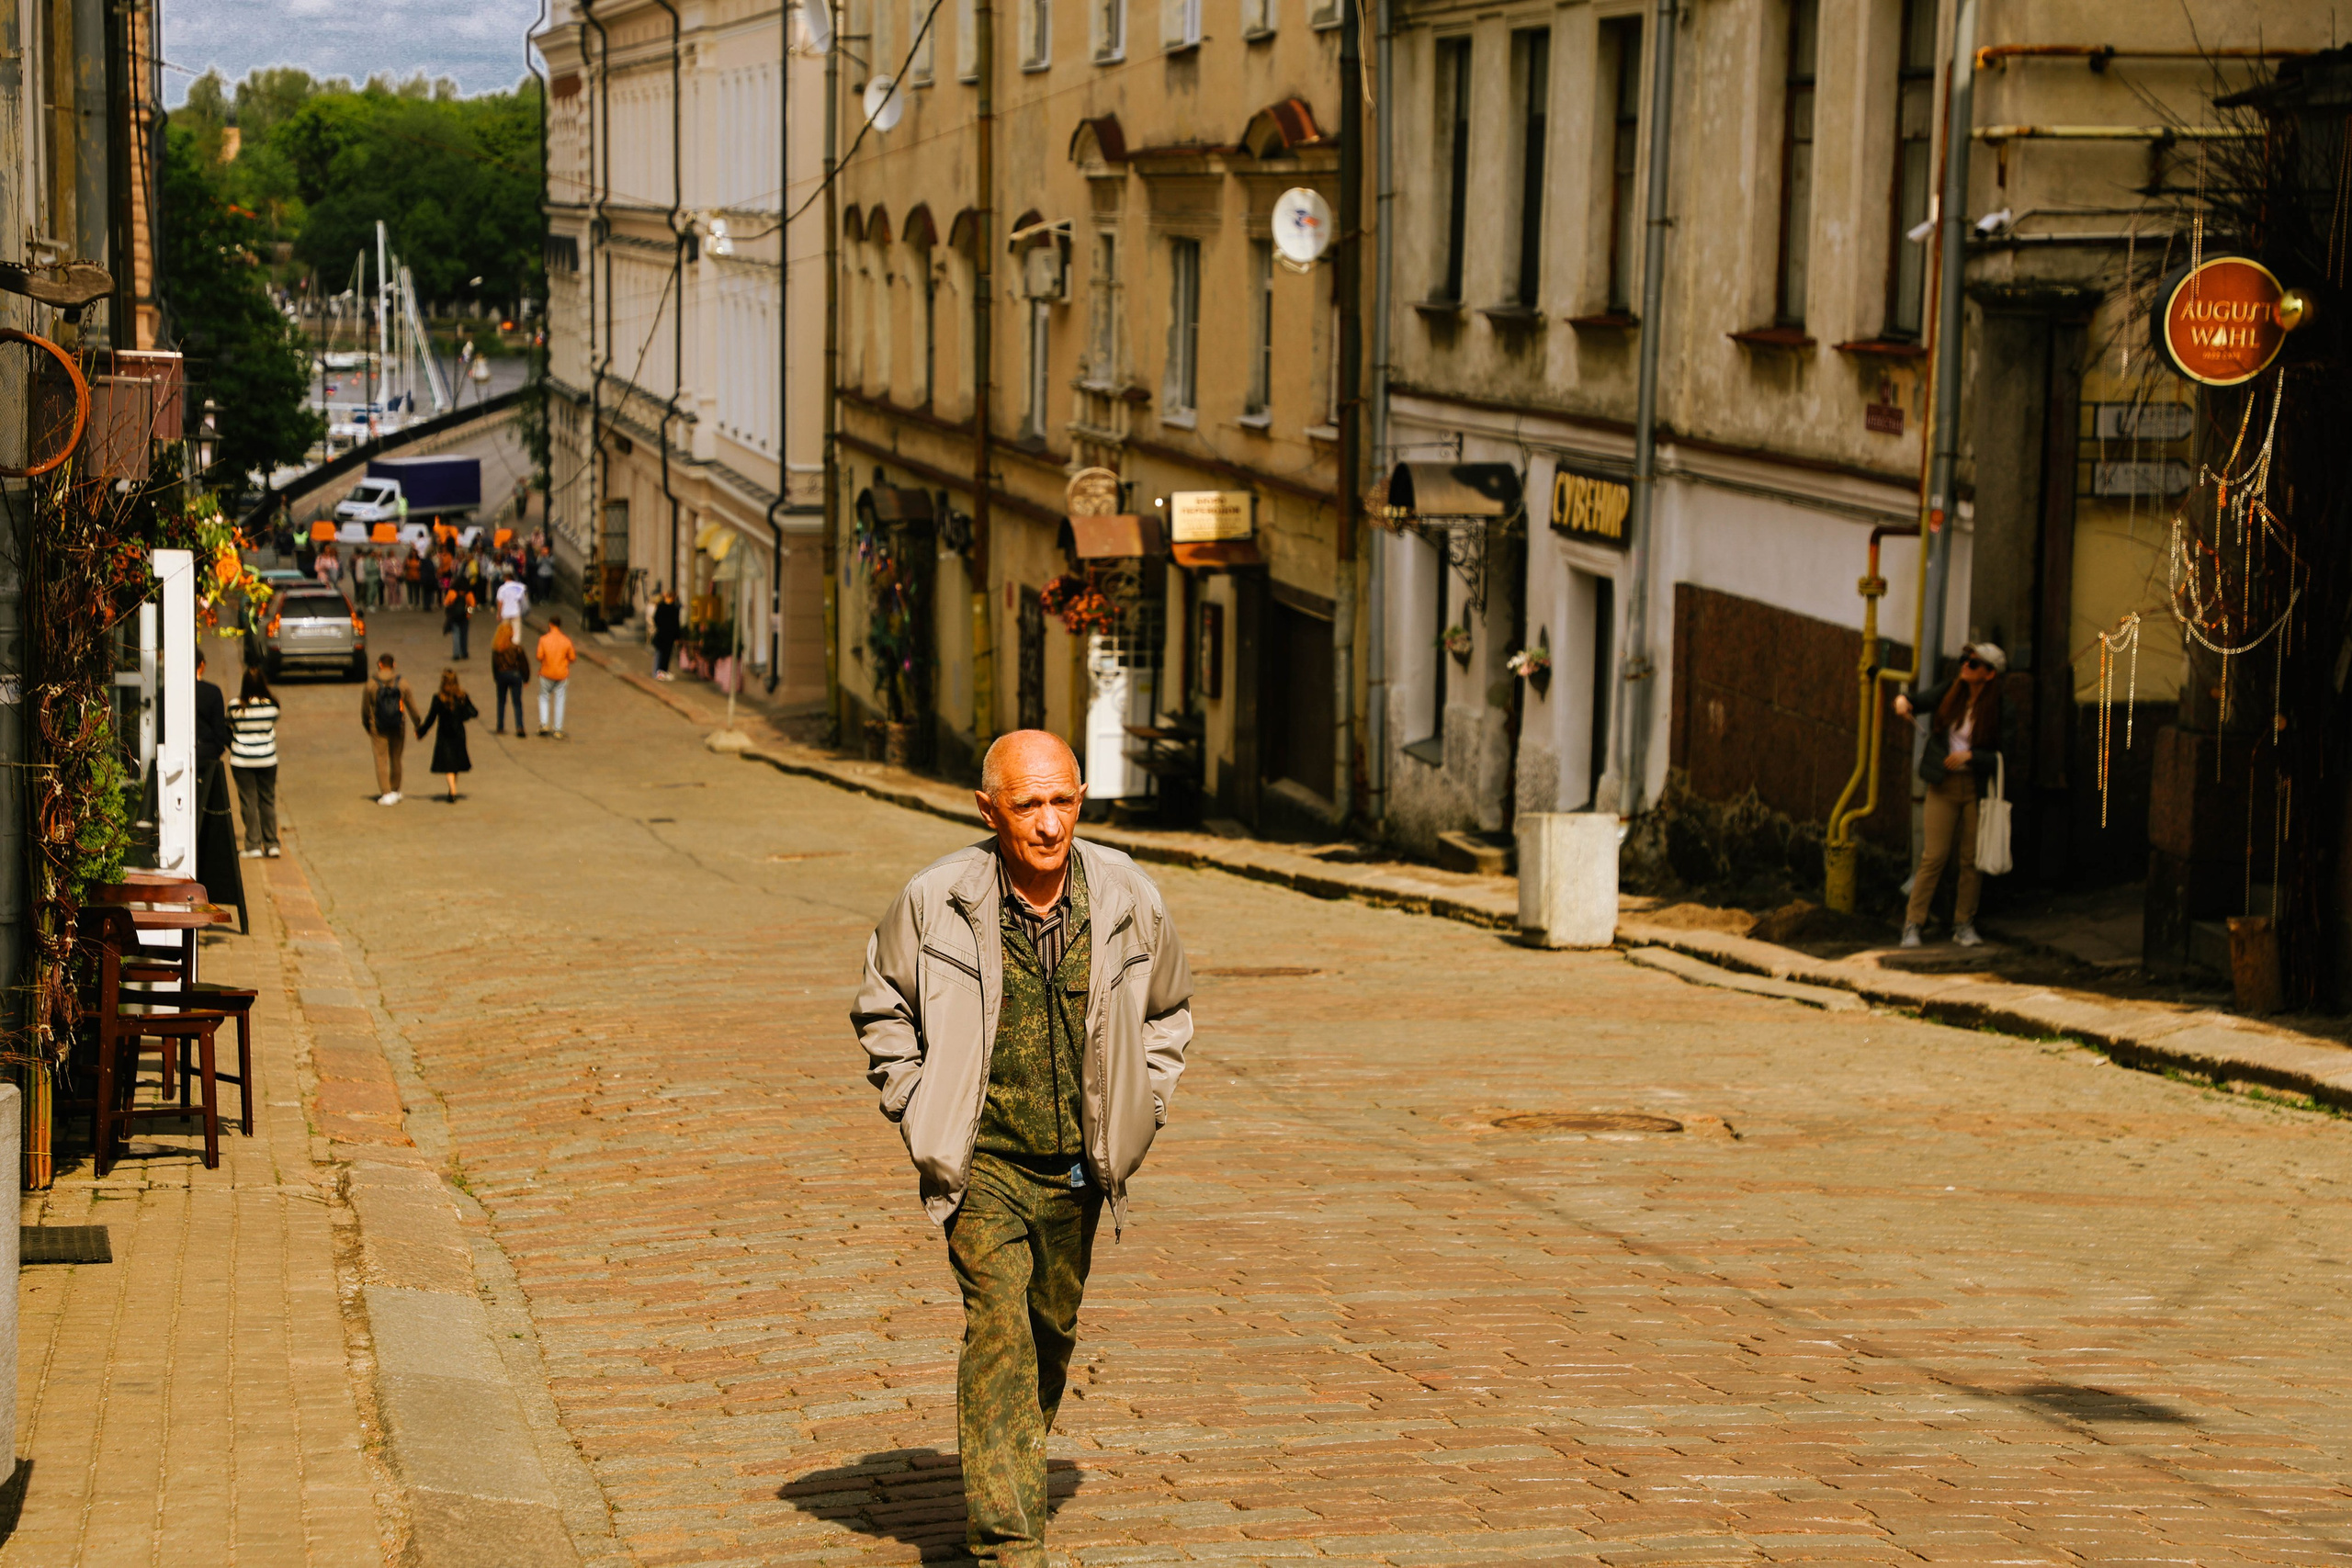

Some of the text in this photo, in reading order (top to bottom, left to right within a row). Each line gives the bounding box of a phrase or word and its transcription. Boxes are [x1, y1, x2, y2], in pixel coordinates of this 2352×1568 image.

[2180, 301, 2270, 322] AUGUST
[2191, 324, 2260, 348] WAHL
[1553, 471, 1630, 538] СУВЕНИР
